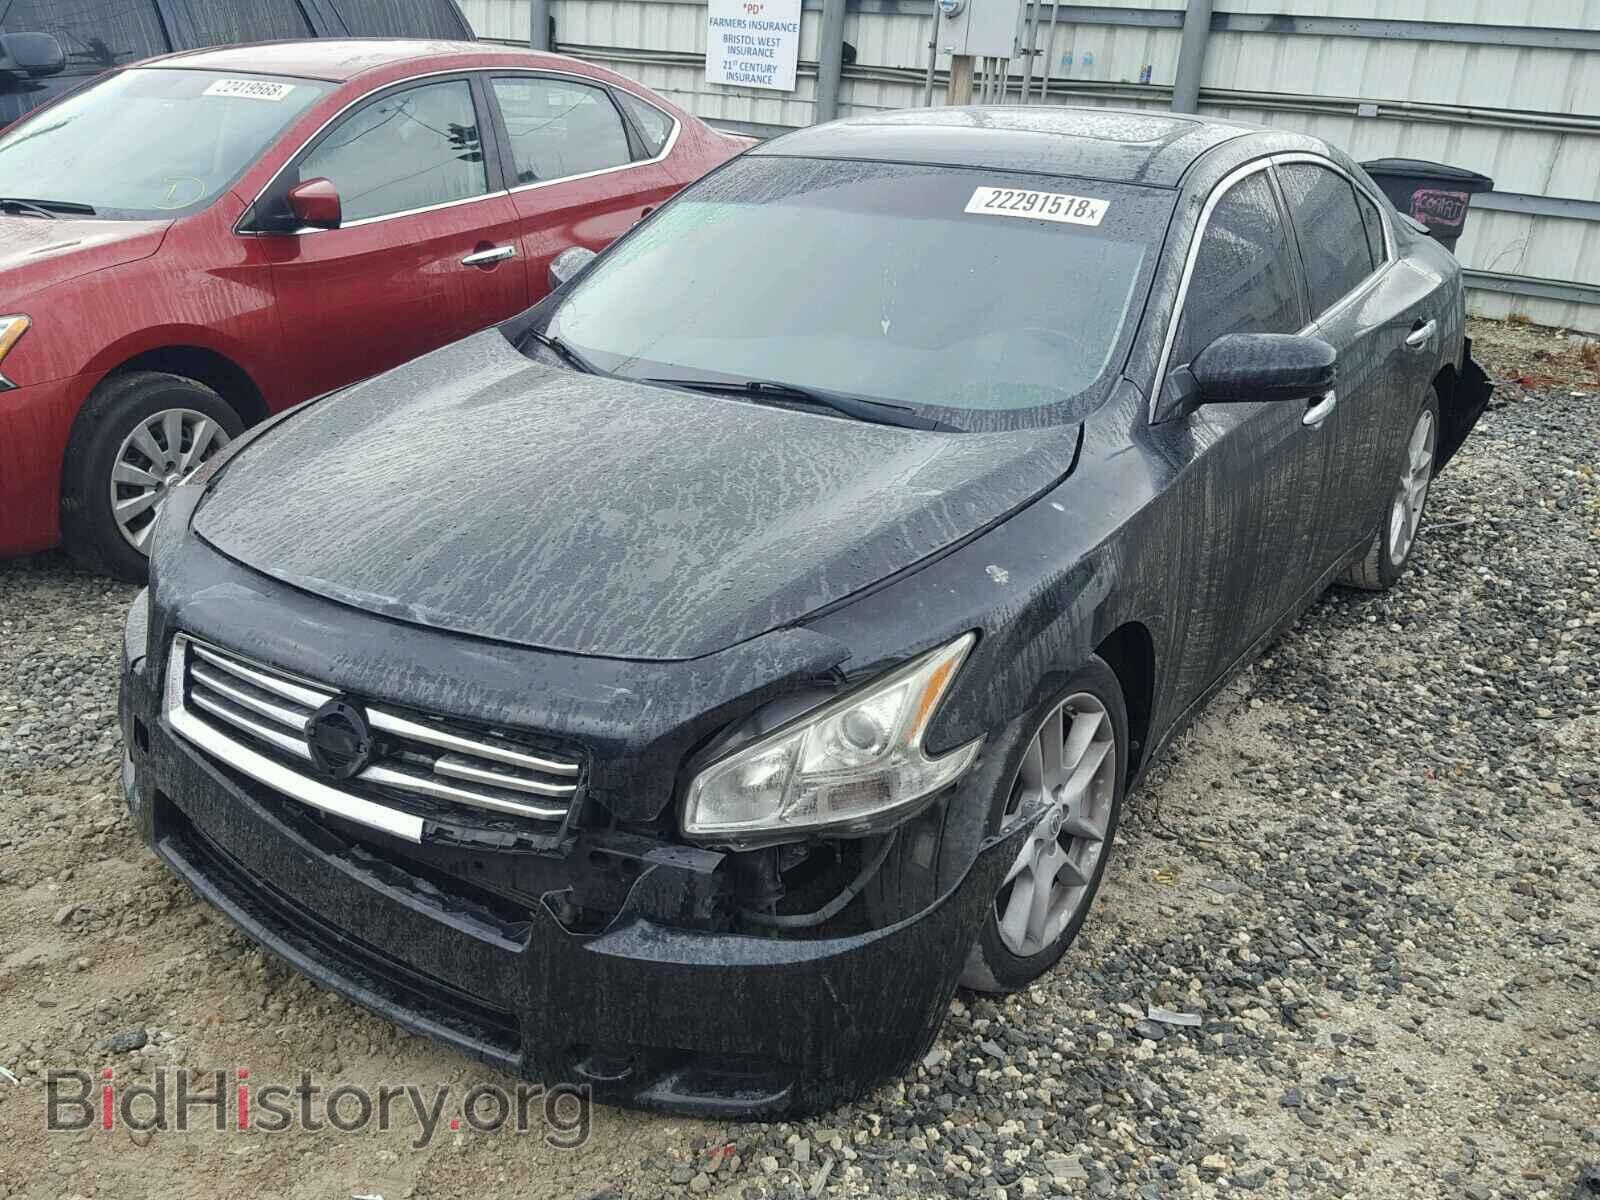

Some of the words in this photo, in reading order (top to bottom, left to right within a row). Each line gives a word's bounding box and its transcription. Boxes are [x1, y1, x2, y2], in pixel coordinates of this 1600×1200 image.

[709, 16, 747, 29] FARMERS
[748, 21, 798, 33] INSURANCE
[722, 33, 755, 46] BRISTOL
[757, 37, 781, 47] WEST
[727, 45, 775, 58] INSURANCE
[740, 62, 778, 73] CENTURY
[726, 71, 773, 85] INSURANCE
